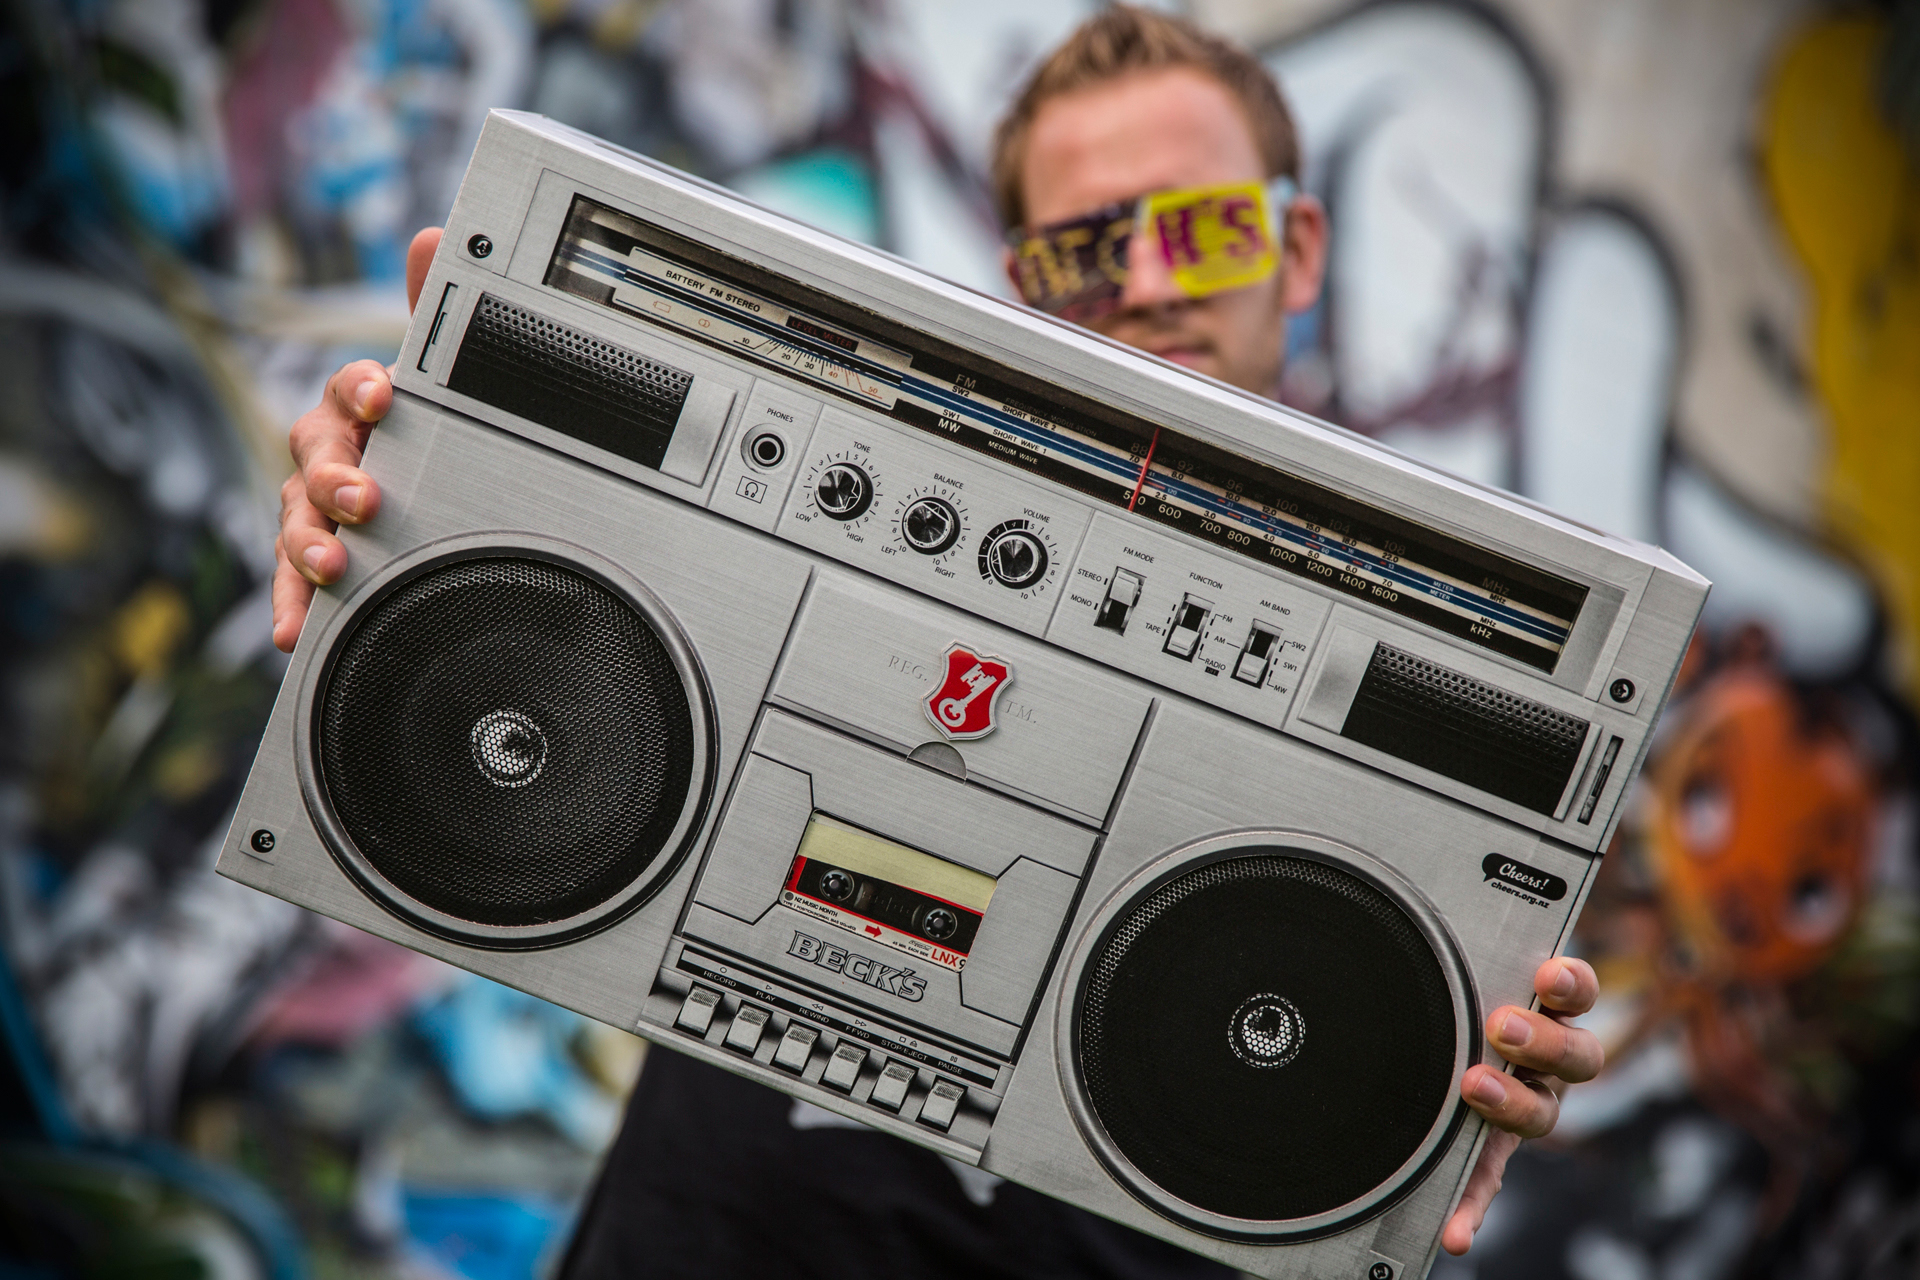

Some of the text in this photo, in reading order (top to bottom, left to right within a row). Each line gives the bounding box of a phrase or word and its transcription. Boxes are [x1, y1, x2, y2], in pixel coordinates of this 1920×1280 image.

[666, 270, 760, 313] BATTERY FM STEREO
[791, 320, 853, 349] LEVEL METER
[742, 337, 878, 394] 10 20 30 40 50
[955, 373, 1097, 437] FM FREQUENCY MODULATION
[766, 407, 794, 423] PHONES
[853, 441, 871, 453] TONE
[933, 473, 964, 490] BALANCE
[952, 385, 970, 398] SW2
[1001, 405, 1027, 420] SHORT
[1029, 415, 1050, 429] WAVE
[1129, 454, 1140, 463] 7.0
[1171, 471, 1184, 481] 8.0
[1225, 491, 1240, 502] 10.0
[1262, 506, 1277, 516] 12.0
[1305, 522, 1321, 533] 15.0
[1342, 536, 1357, 547] 18.0
[1382, 552, 1399, 563] 22.0
[1489, 592, 1507, 605] MHz
[795, 512, 812, 523] LOW
[942, 409, 961, 421] SW1
[992, 428, 1018, 443] SHORT
[1020, 438, 1040, 452] WAVE
[1155, 491, 1167, 501] 2.5
[1203, 510, 1216, 520] 3.0
[1263, 533, 1275, 543] 4.0
[1307, 550, 1320, 560] 5.0
[1345, 565, 1358, 575] 6.0
[1381, 578, 1393, 588] 7.0
[1480, 616, 1497, 628] MHz
[1023, 508, 1050, 523] VOLUME
[1131, 443, 1148, 456] 88
[1178, 460, 1194, 473] 92
[1227, 479, 1243, 493] 96
[1275, 498, 1299, 514] 100
[1328, 518, 1350, 534] 104
[1384, 540, 1406, 556] 108
[1482, 577, 1511, 596] MHz
[937, 418, 1493, 640] MW MEDIUM WAVE 50 600 700 800 1000 1200 1400 1600 kHz
[846, 532, 864, 543] HIGH
[880, 545, 897, 556] LEFT
[1123, 546, 1155, 563] FM MODE
[935, 566, 955, 578] RIGHT
[1077, 568, 1102, 582] STEREO
[1189, 572, 1223, 589] FUNCTION
[1433, 580, 1454, 592] METER
[1070, 594, 1092, 607] MONO
[1429, 589, 1450, 601] METER
[1259, 599, 1291, 616] AM BAND
[1222, 614, 1233, 623] FM
[1145, 622, 1161, 633] TAPE
[1214, 635, 1225, 644] AM
[1291, 641, 1307, 652] SW2
[1205, 658, 1226, 671] RADIO
[1283, 661, 1298, 671] SW1
[888, 655, 1037, 724] REG. TM.
[1273, 685, 1288, 694] MW
[1499, 863, 1550, 890] Cheers!
[1491, 881, 1550, 909] cheers.org.nz
[802, 899, 818, 909] MUSIC
[819, 906, 838, 917] MONTH
[908, 945, 919, 954] EACH
[786, 930, 928, 1002] BECK'S
[703, 970, 737, 987] RECORD
[755, 990, 777, 1002] PLAY
[798, 1007, 830, 1023] REWIND
[880, 1039, 928, 1061] STOP/EJECT
[937, 1061, 963, 1075] PAUSE
